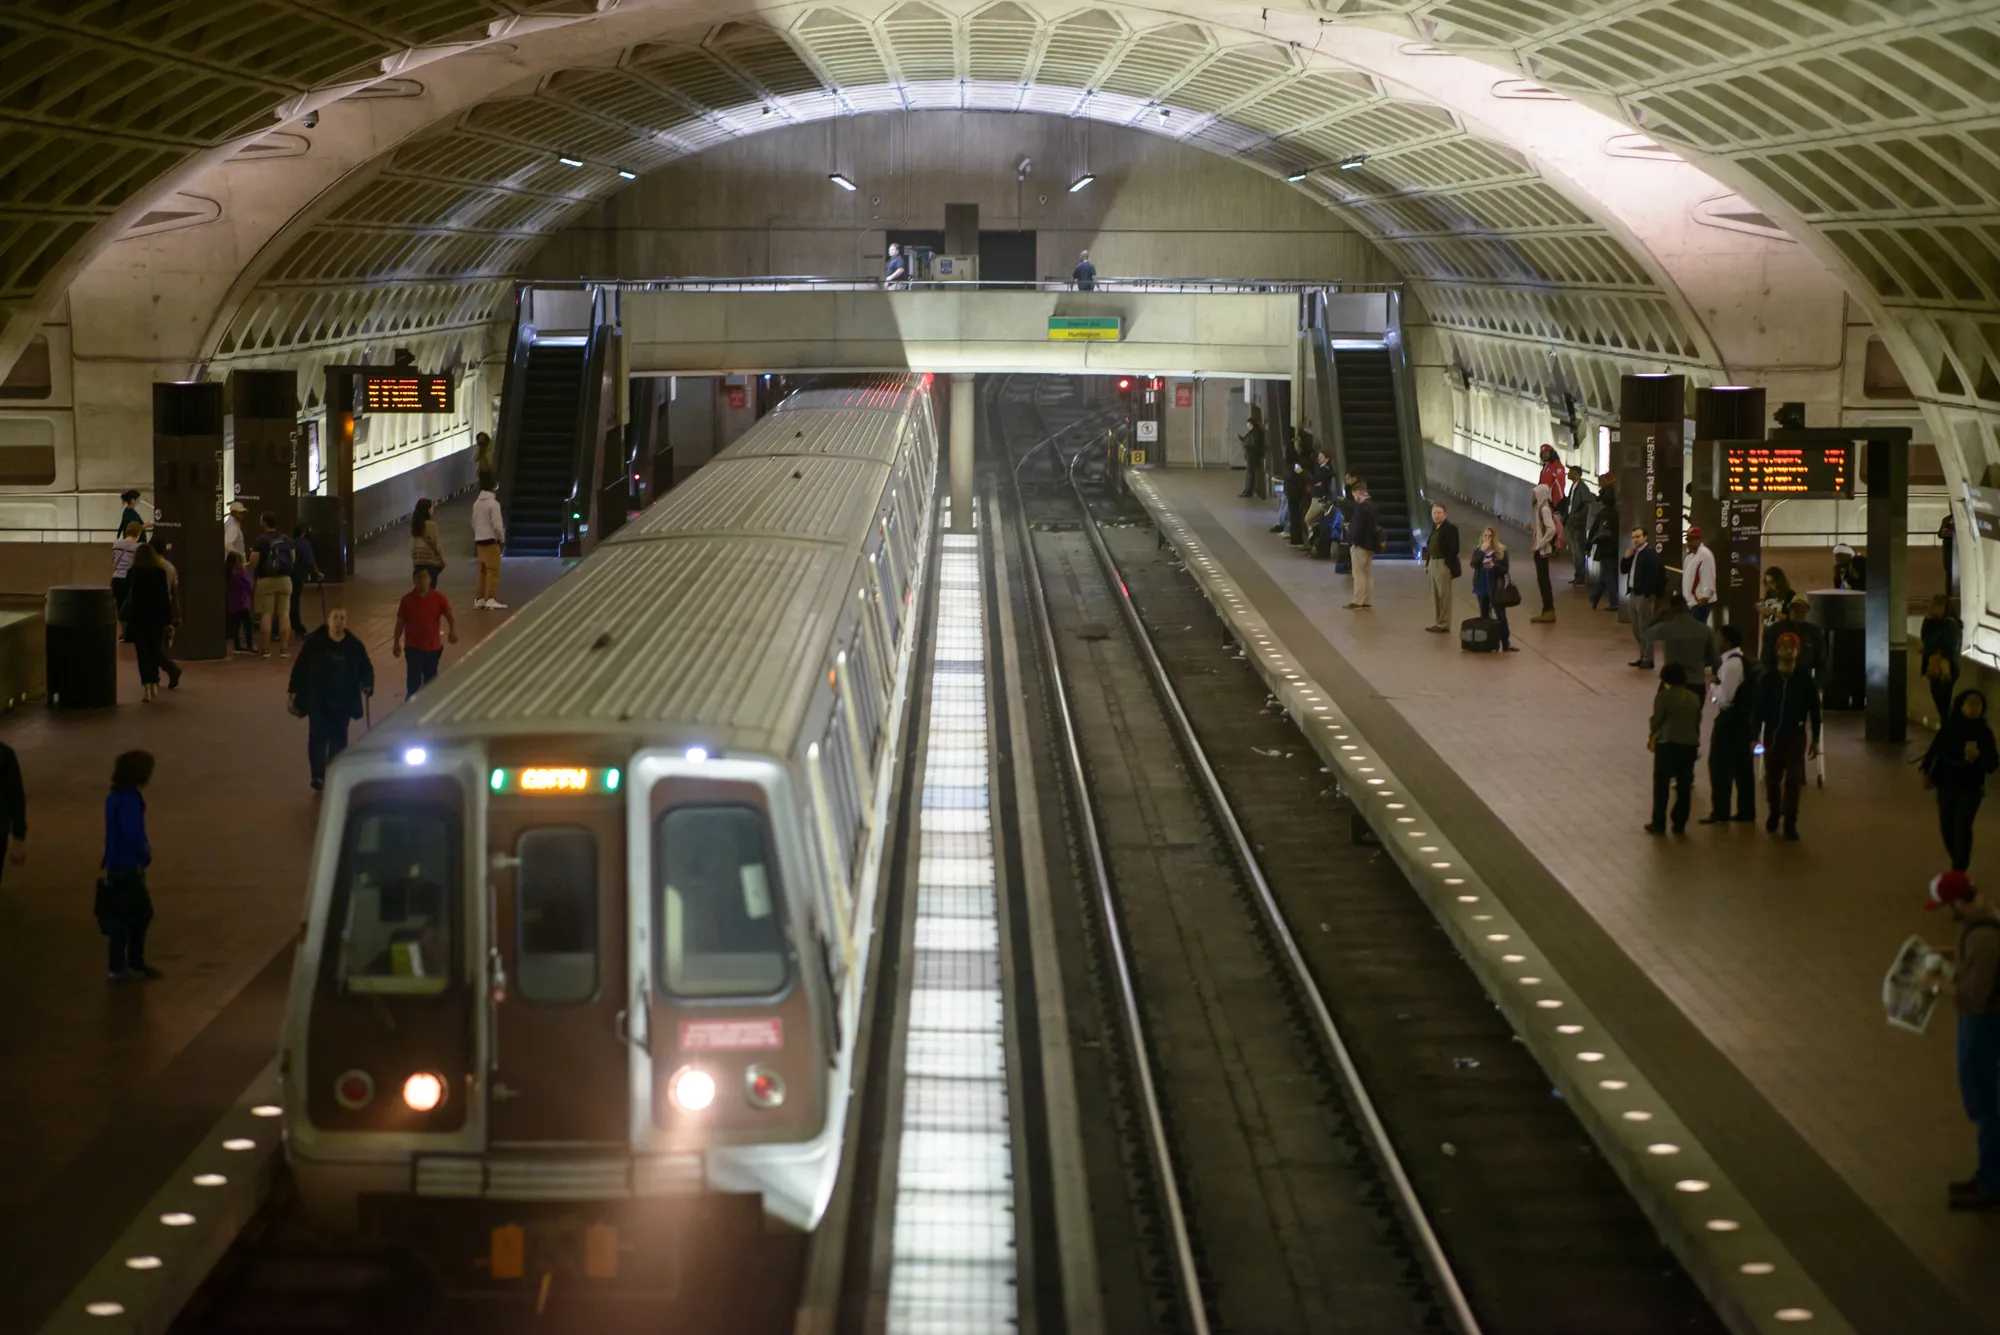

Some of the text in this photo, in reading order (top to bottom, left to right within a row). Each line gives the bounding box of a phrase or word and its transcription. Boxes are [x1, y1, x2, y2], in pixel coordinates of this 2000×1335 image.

[1134, 451, 1142, 463] 8
[1646, 436, 1655, 501] L'Enfant Plaza
[1721, 500, 1730, 528] Plaza
